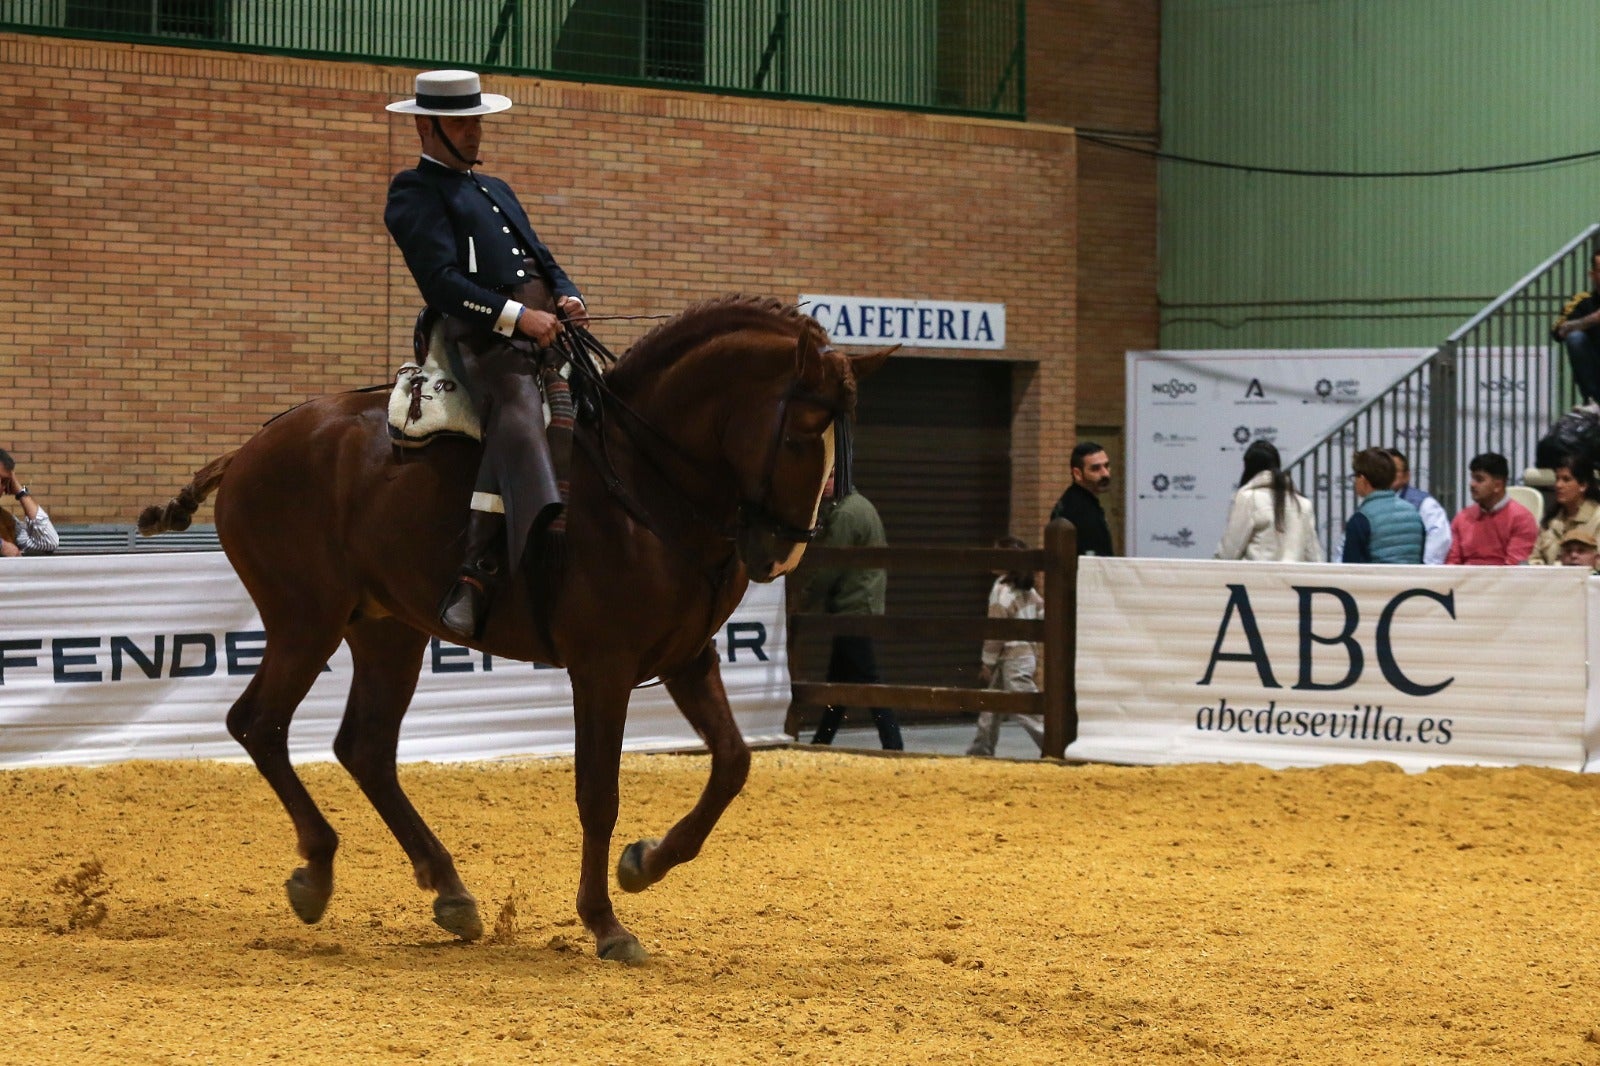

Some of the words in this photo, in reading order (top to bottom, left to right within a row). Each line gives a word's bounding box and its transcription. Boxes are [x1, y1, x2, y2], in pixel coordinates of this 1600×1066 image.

[811, 303, 995, 341] CAFETERIA
[0, 631, 332, 685] FENDE
[1196, 584, 1456, 696] ABC
[1196, 699, 1453, 744] abcdesevilla.es
